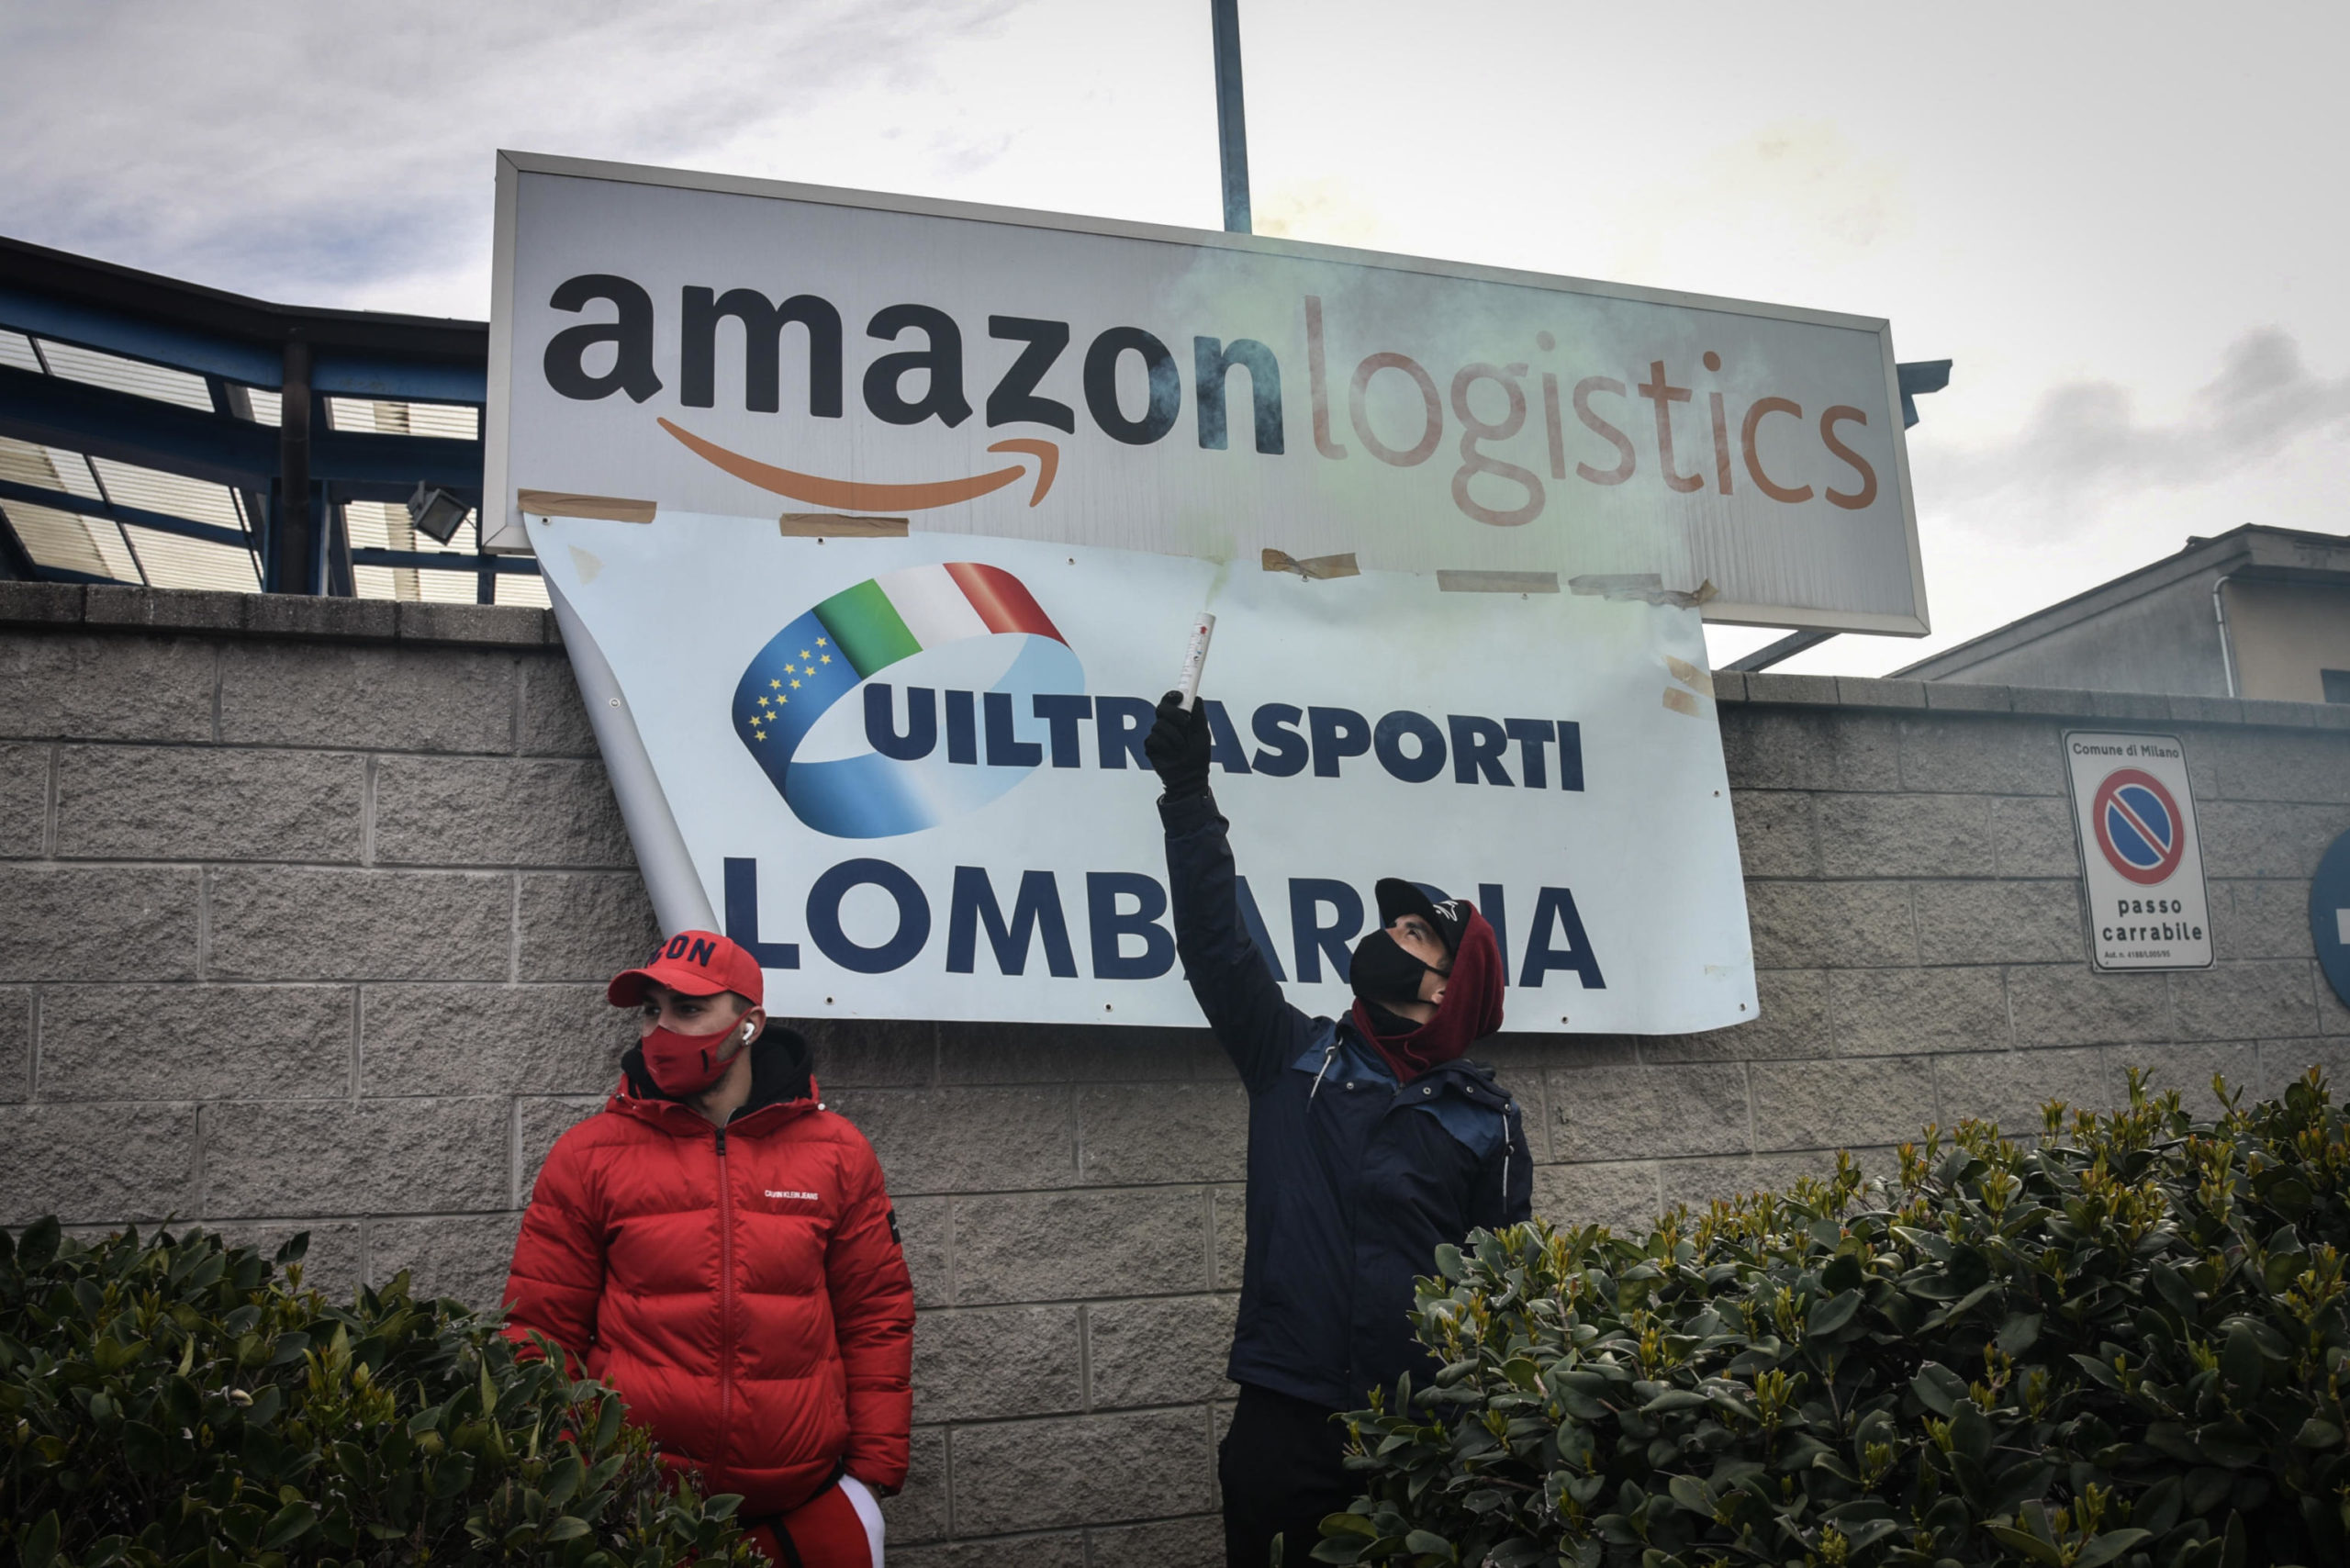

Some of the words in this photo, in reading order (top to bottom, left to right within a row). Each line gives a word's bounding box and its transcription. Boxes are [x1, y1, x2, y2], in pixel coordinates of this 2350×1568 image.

[2073, 743, 2123, 756] Comune
[2126, 744, 2138, 756] di
[2141, 745, 2179, 758] Milano
[2118, 900, 2181, 917] passo
[723, 857, 1606, 990] LOMBRIA
[2102, 922, 2202, 941] carrabile
[644, 935, 716, 968] CON
